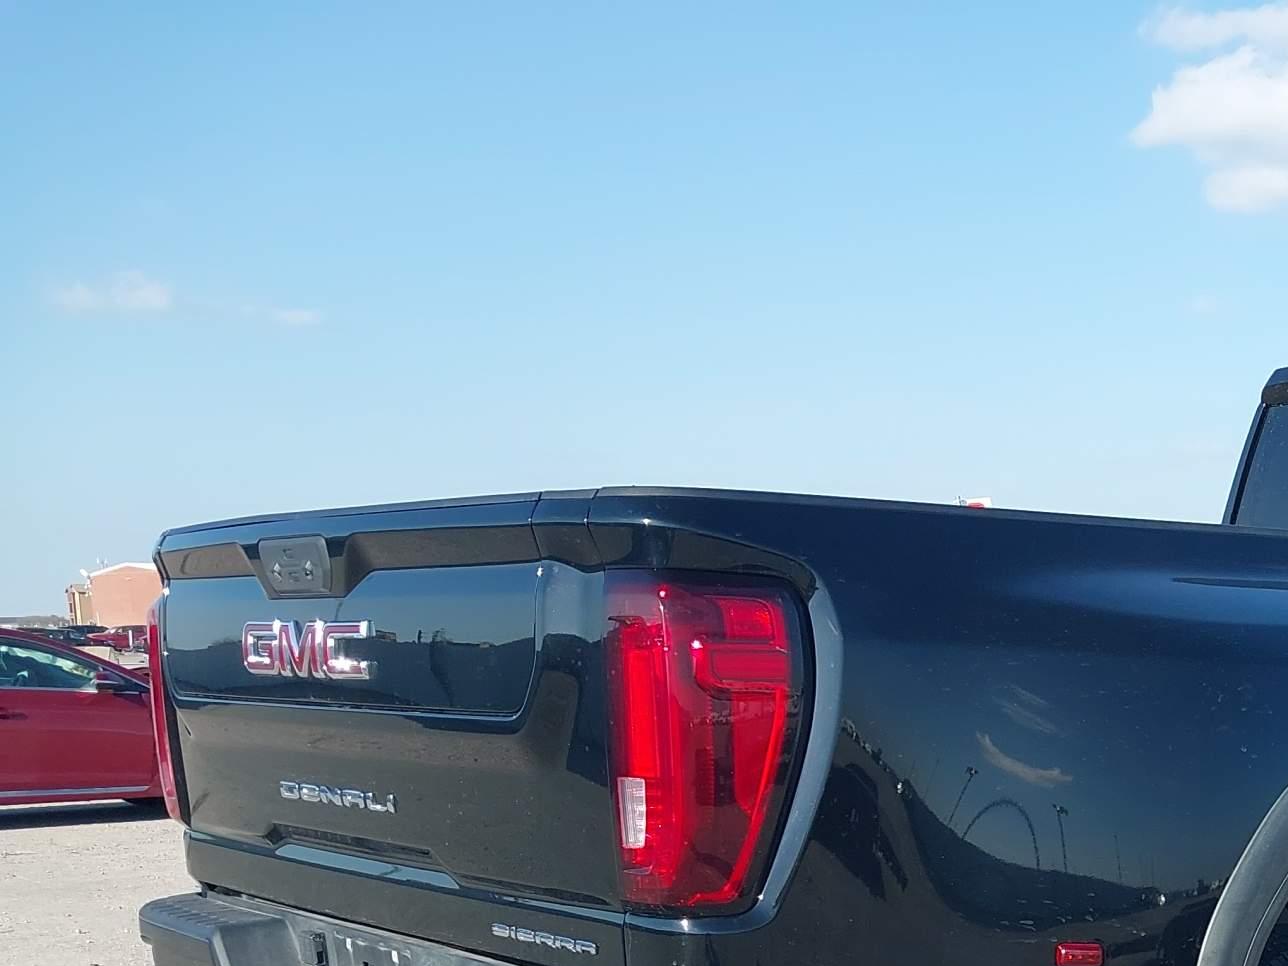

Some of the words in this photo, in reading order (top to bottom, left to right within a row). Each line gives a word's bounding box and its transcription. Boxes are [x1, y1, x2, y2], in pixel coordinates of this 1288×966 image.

[242, 618, 376, 680] GMC
[280, 781, 397, 813] DENALI
[491, 923, 598, 956] SIERRA
